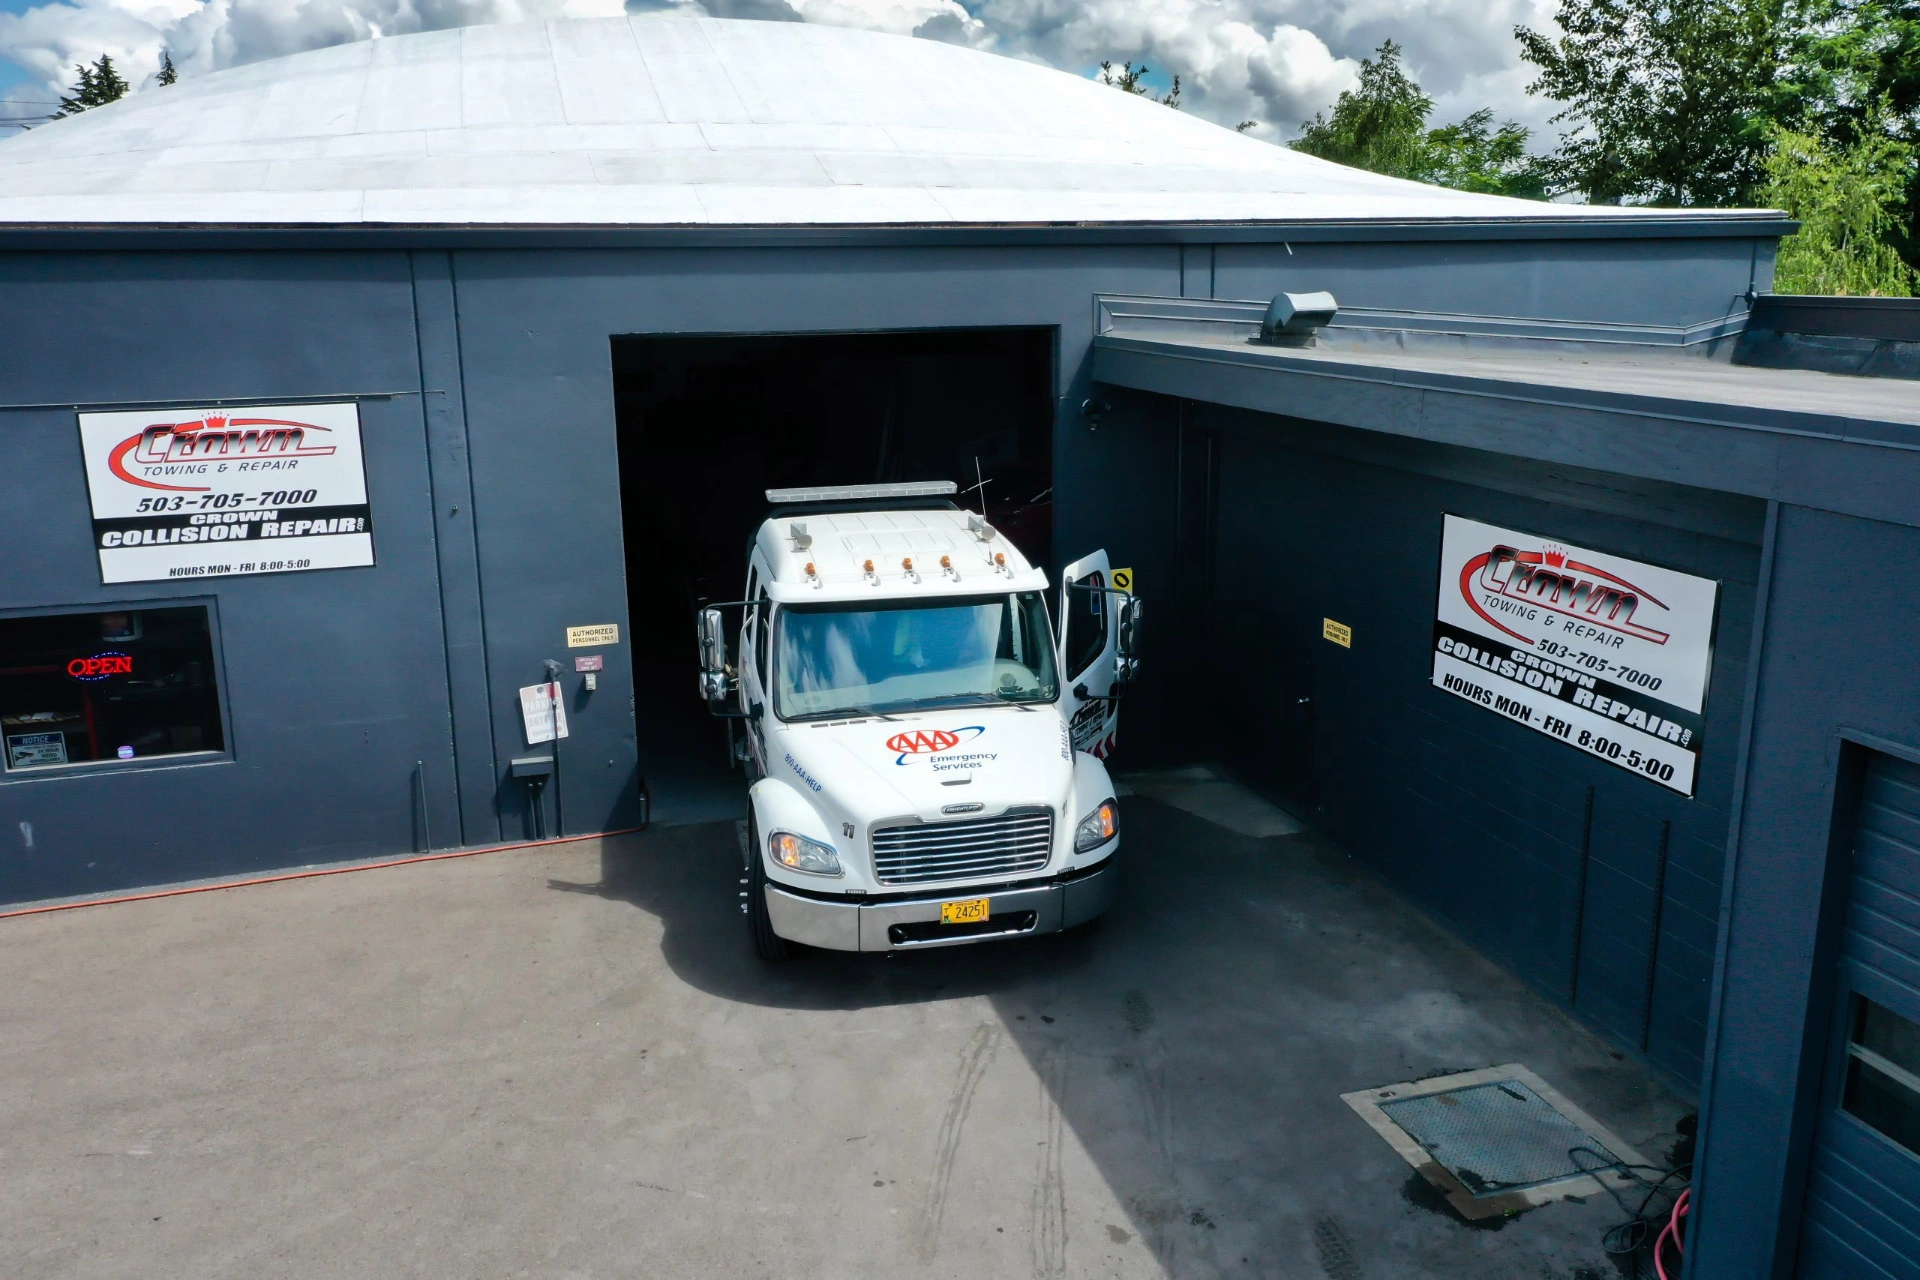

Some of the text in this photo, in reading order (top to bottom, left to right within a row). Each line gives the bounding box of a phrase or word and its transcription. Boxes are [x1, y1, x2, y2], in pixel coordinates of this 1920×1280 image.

[135, 424, 336, 463] Crown
[143, 460, 299, 476] TOWING & REPAIR
[136, 489, 318, 512] 503-705-7000
[190, 510, 278, 525] CROWN
[102, 523, 249, 547] COLLISION
[169, 566, 205, 577] HOURS
[207, 564, 231, 575] MON
[239, 562, 255, 572] FRI
[260, 559, 310, 571] 8:00-5:00
[1480, 544, 1669, 645] Crown
[573, 628, 614, 637] AUTHORIZED
[1483, 594, 1625, 649] TOWING & REPAIR
[573, 636, 600, 644] PERSONNEL
[67, 656, 132, 676] OPEN
[1437, 636, 1564, 696] COLLISION
[1510, 650, 1597, 689] CROWN
[1537, 638, 1663, 692] 503-705-7000
[1442, 673, 1492, 705] HOURS
[1494, 694, 1533, 722] MON
[1542, 714, 1573, 738] FRI
[1577, 729, 1675, 782] 8:00-5:00
[22, 735, 49, 744] NOTICE
[888, 730, 957, 753] AAA
[930, 753, 998, 763] Emergency
[933, 762, 982, 771] Services
[784, 753, 822, 793] 800-AAA-HELP
[956, 904, 985, 919] 24251
